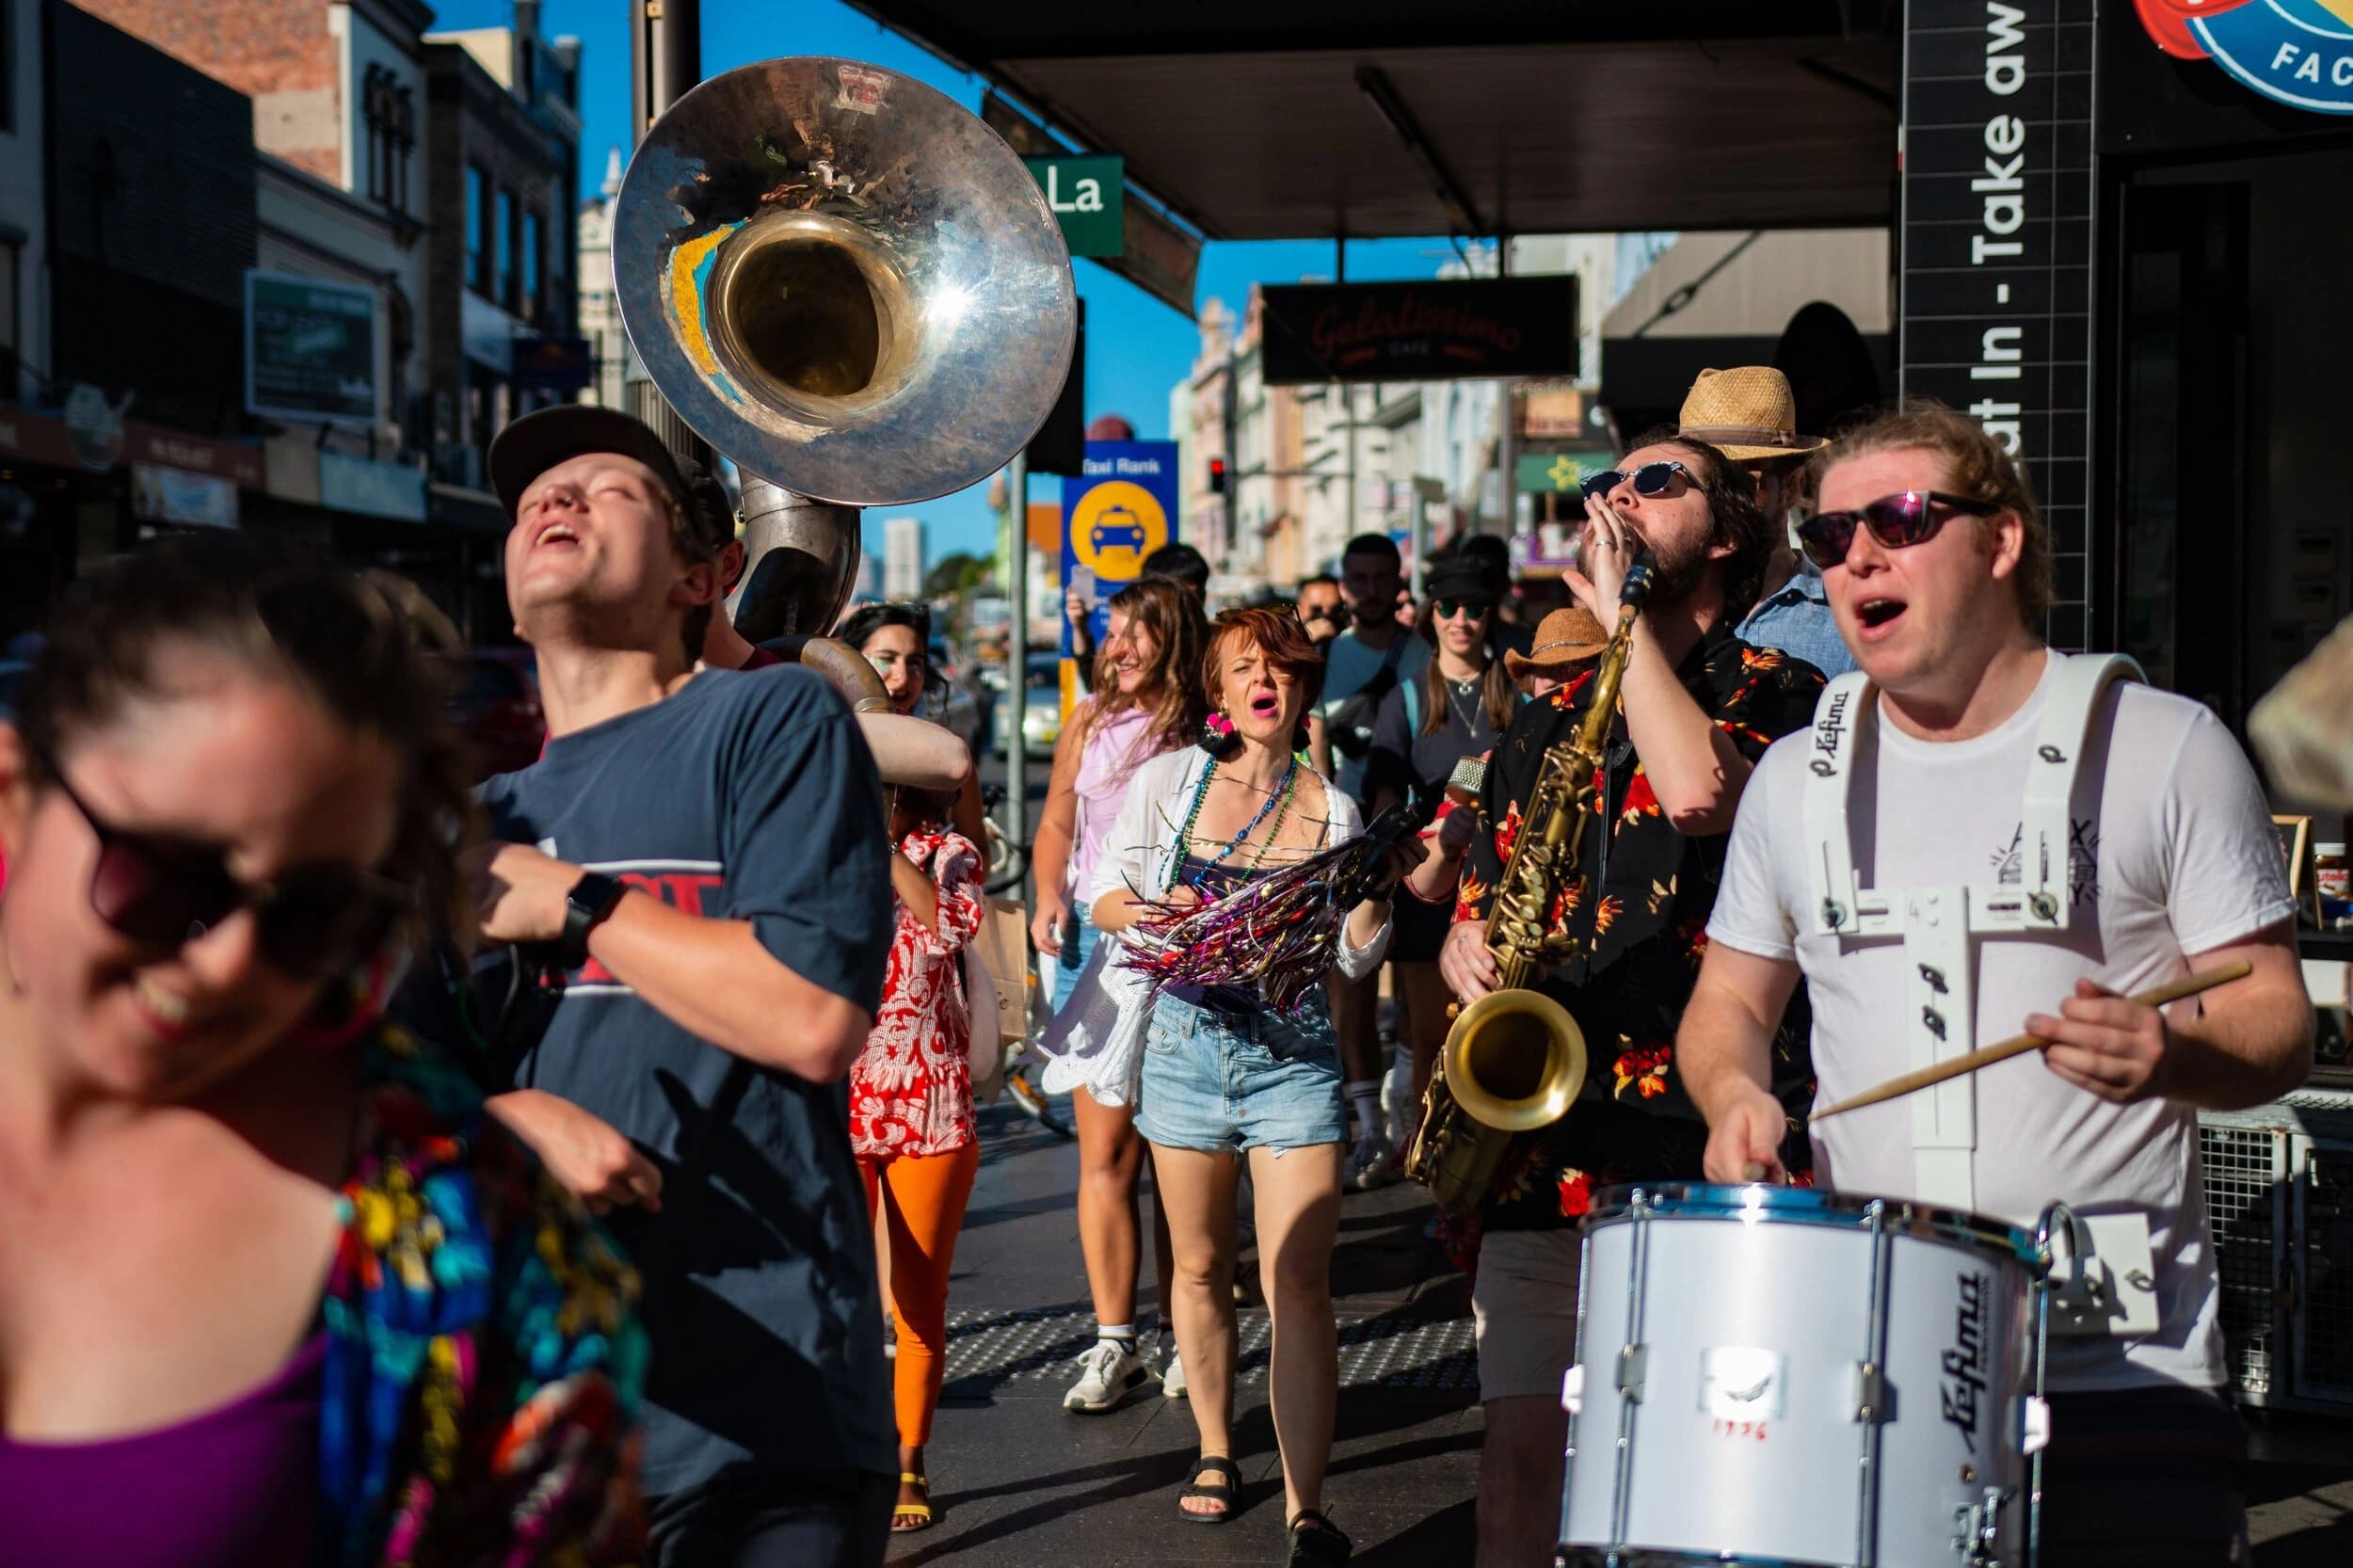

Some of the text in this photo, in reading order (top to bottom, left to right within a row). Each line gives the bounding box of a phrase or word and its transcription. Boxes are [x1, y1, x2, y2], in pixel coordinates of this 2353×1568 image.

[1984, 1, 2025, 96] aw
[2270, 41, 2353, 87] FAC
[1047, 165, 1104, 212] La
[1971, 114, 2025, 264] Take
[1970, 327, 2022, 379] In
[1970, 398, 2022, 478] at
[1083, 457, 1160, 474] Taxi Rank
